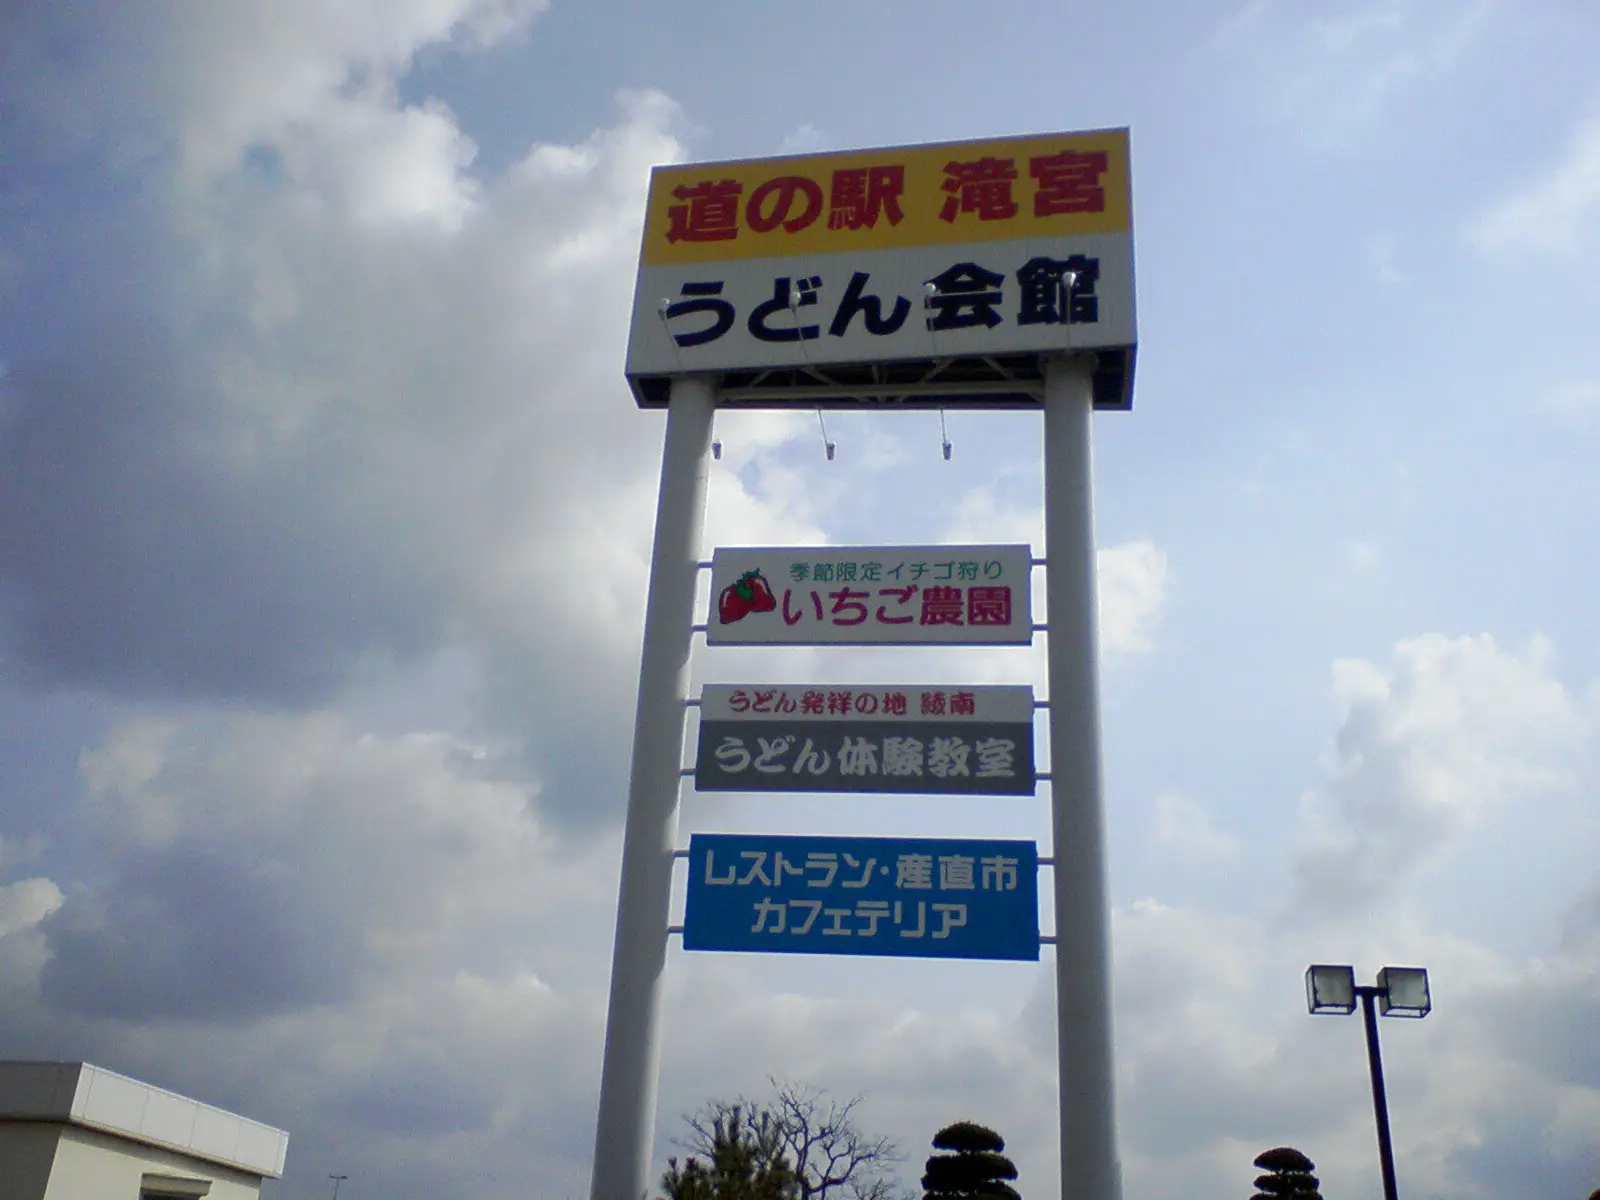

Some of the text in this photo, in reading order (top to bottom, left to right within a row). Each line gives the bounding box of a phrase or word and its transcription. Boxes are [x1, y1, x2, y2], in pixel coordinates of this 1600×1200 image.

[665, 148, 1109, 245] 道の駅 滝宮
[665, 253, 1100, 349] うどん会館
[789, 560, 1004, 583] 季節限定イチゴ狩り
[782, 584, 1012, 626] いちご農園
[728, 688, 907, 716] うどん発祥の地
[714, 734, 1017, 778] うどん体験教室
[704, 849, 1019, 892] レストラン・産直市
[751, 897, 968, 940] カフェテリア
